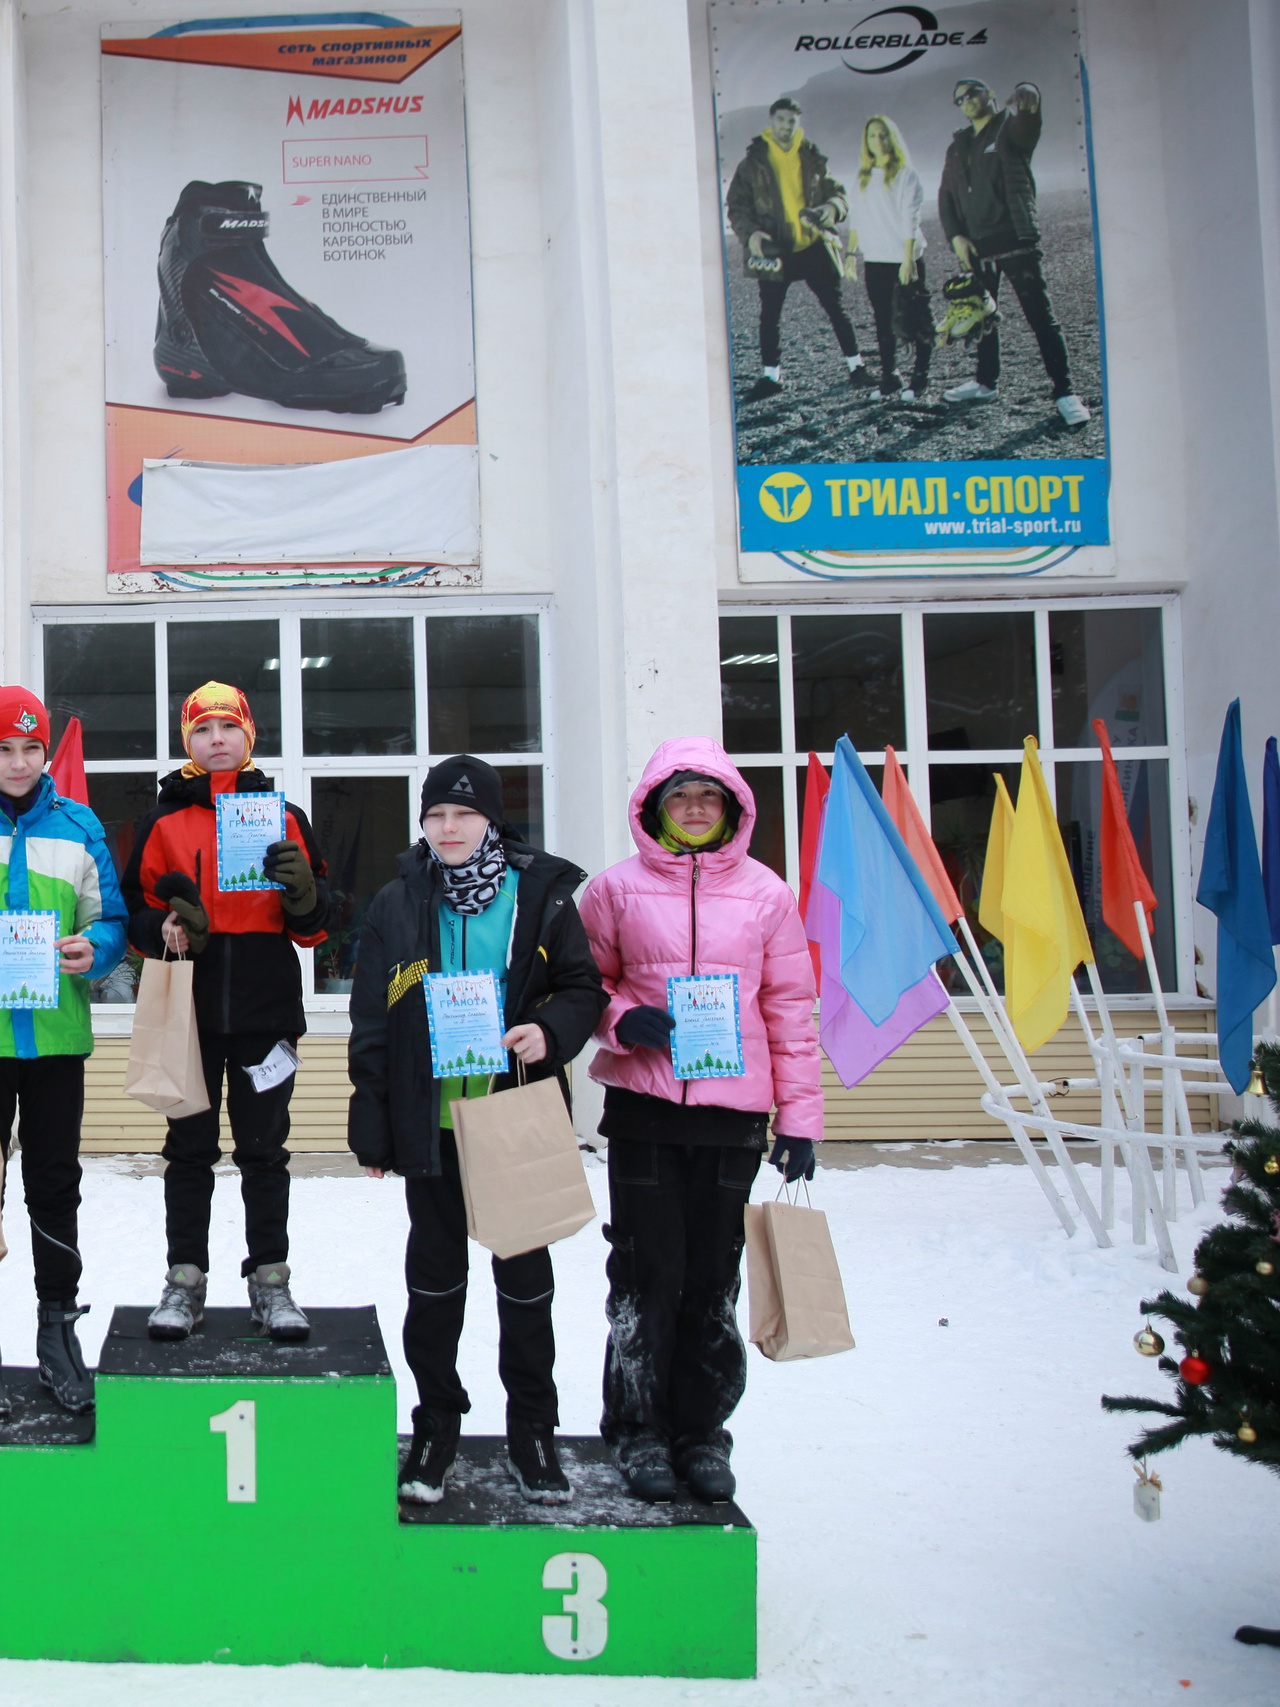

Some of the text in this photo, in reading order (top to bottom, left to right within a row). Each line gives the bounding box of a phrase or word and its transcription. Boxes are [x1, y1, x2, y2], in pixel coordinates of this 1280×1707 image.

[278, 38, 432, 54] сеть спортивных
[794, 32, 965, 52] ROLLERBLADE
[312, 54, 407, 66] магазинов
[307, 95, 424, 120] MADSHUS
[292, 154, 372, 168] SUPER NANO
[321, 188, 427, 206] ЕДИНСТВЕННЫЙ
[322, 207, 369, 219] В МИРЕ
[322, 219, 407, 233] ПОЛНОСТЬЮ
[323, 232, 413, 247] КАРБОНОВЫЙ
[323, 249, 386, 262] БОТИНОК
[925, 517, 1081, 536] www.trial-sport.ru
[209, 1399, 257, 1504] 1
[541, 1551, 609, 1662] 3
